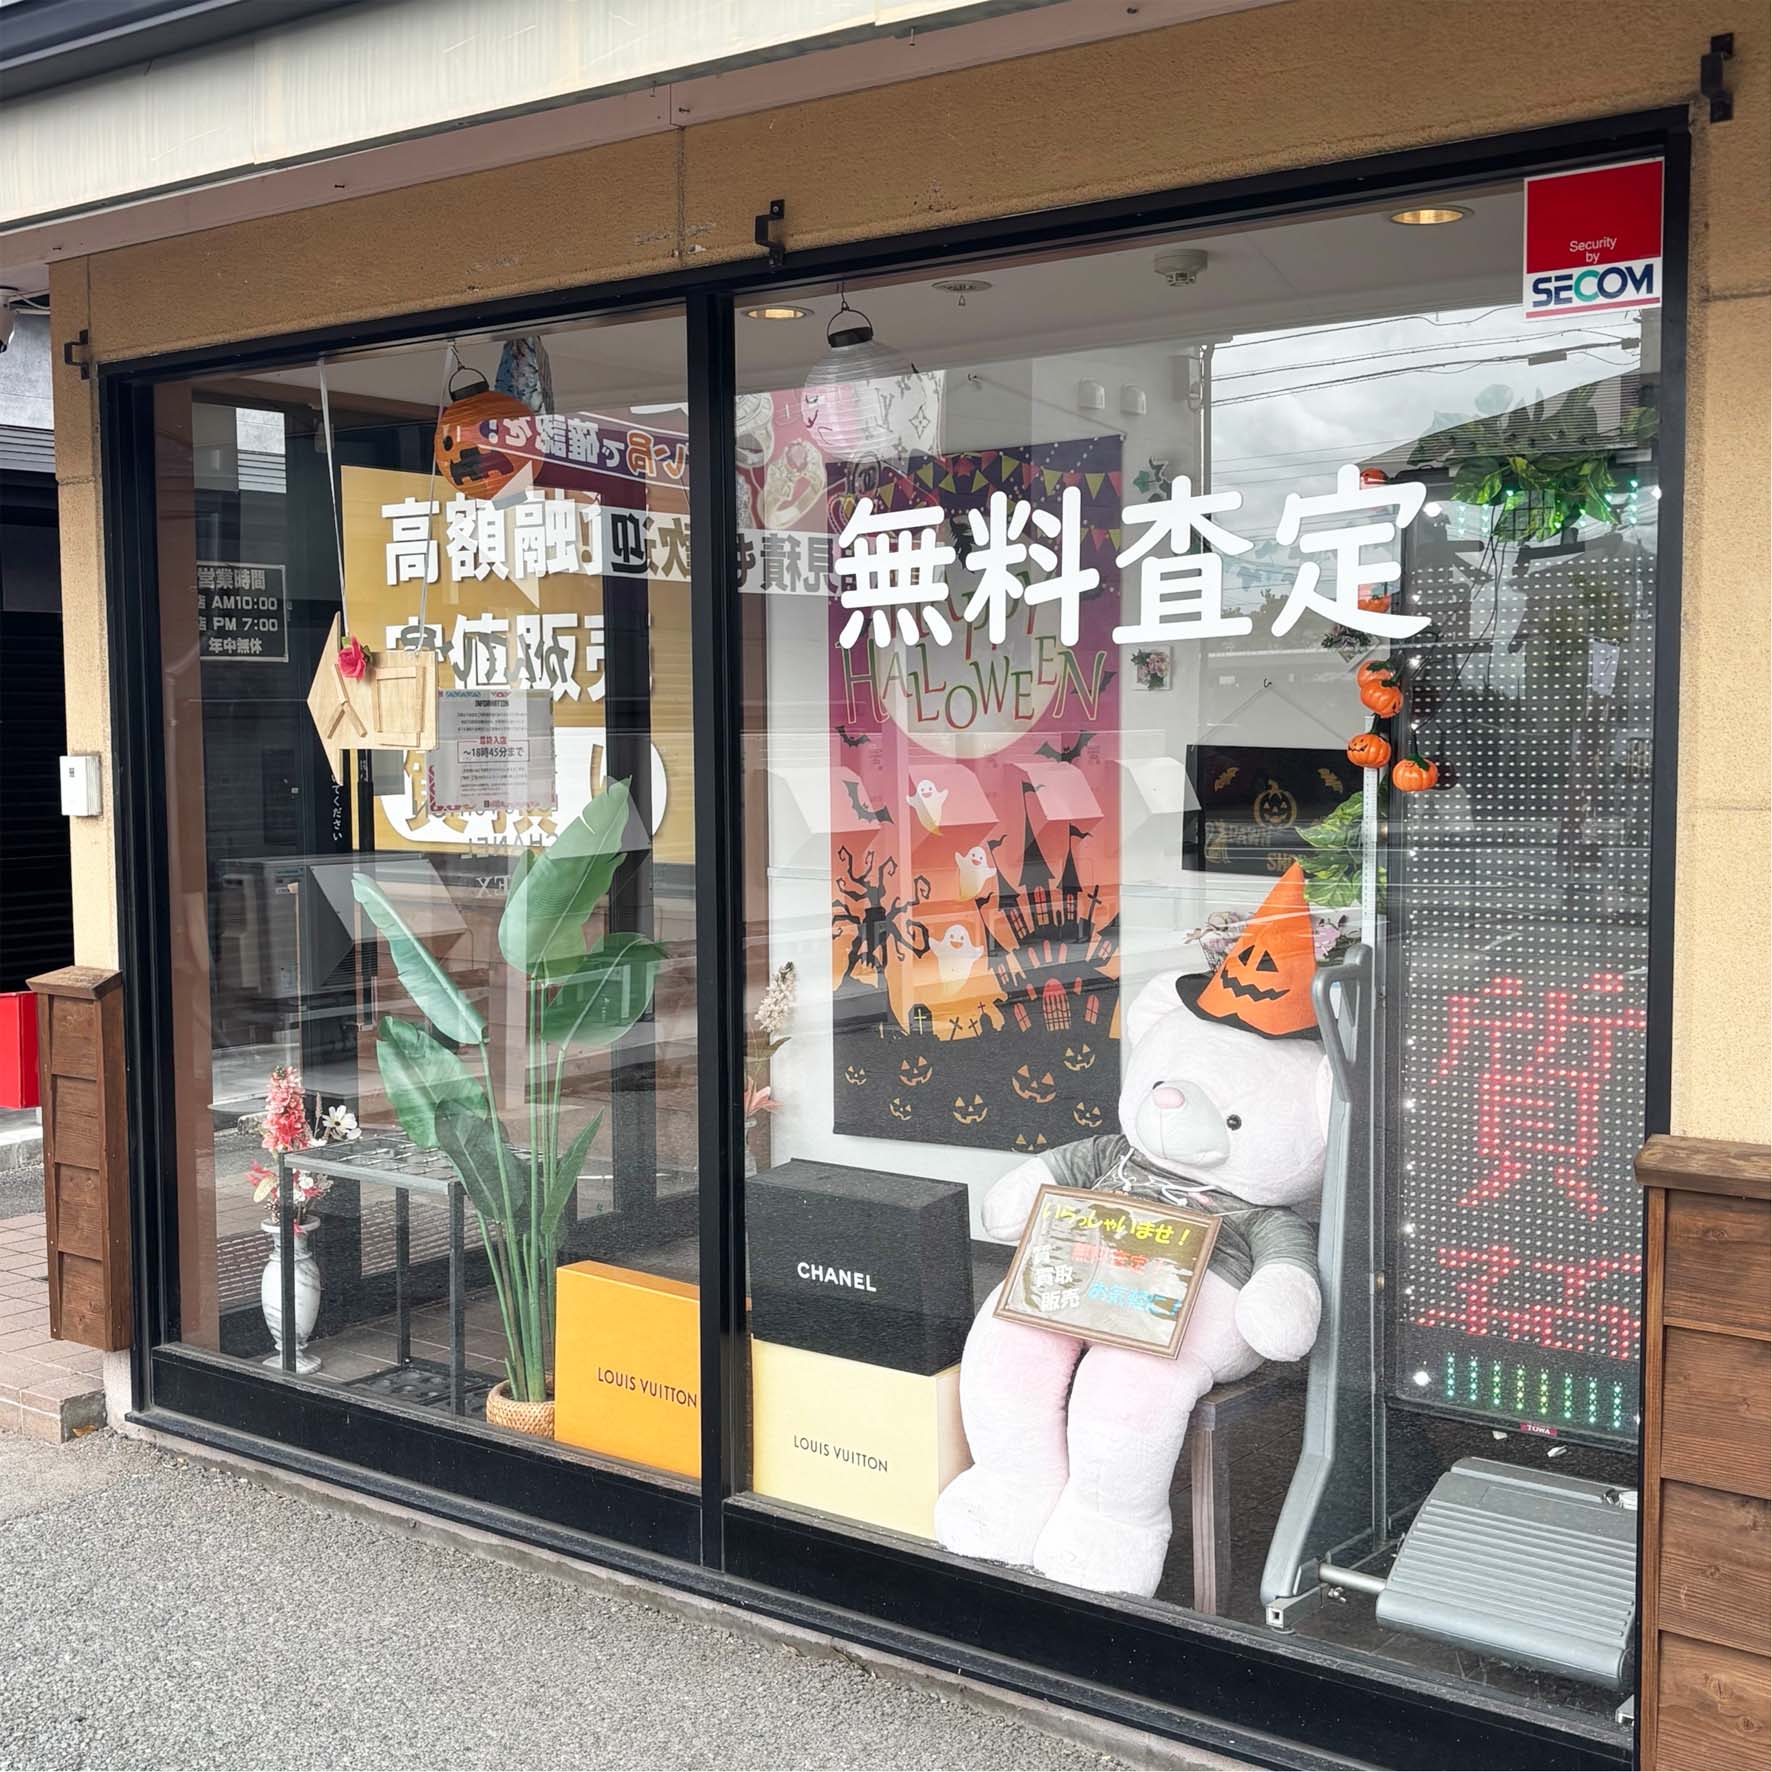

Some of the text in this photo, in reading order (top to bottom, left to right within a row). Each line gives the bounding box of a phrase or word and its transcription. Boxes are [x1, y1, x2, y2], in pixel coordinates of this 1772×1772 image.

[1569, 236, 1617, 252] Security
[1585, 251, 1600, 264] by
[1532, 263, 1654, 308] SECOM
[834, 463, 1432, 648] 無料査定
[213, 617, 237, 631] PM
[242, 617, 279, 632] 7:00
[208, 637, 263, 654] 年中無休
[797, 1262, 877, 1292] CHANEL
[598, 1367, 697, 1408] LOUIS VUITTON
[794, 1435, 888, 1473] LOUIS VUITTON
